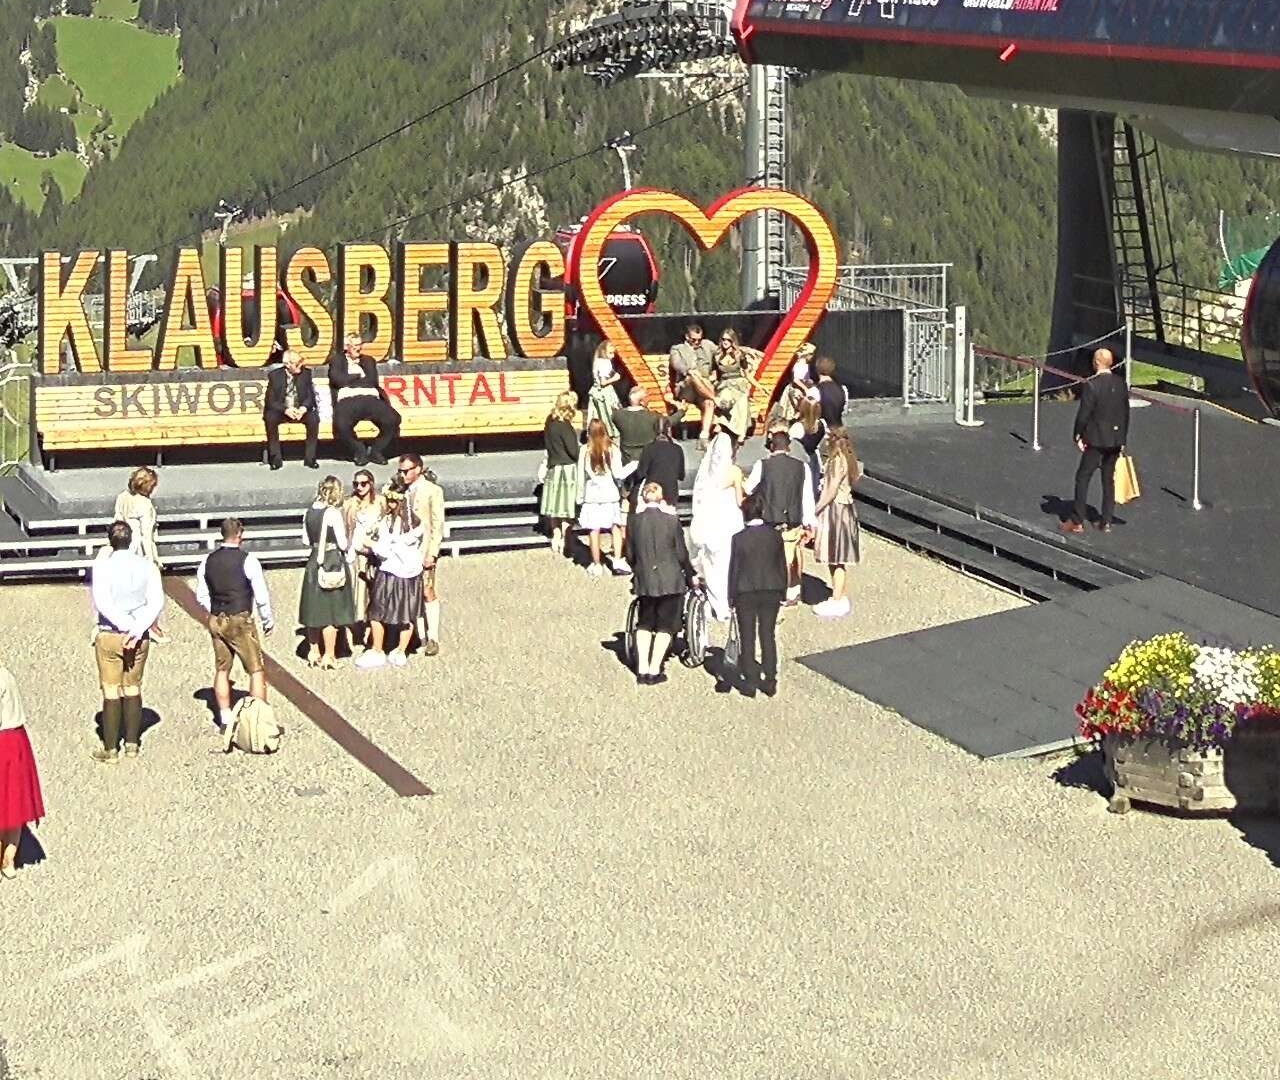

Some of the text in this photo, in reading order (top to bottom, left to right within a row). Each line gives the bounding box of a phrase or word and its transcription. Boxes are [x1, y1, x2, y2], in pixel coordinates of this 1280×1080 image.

[40, 241, 567, 373] KLAUSBERG
[93, 370, 521, 418] SKIWOR RNTAL
